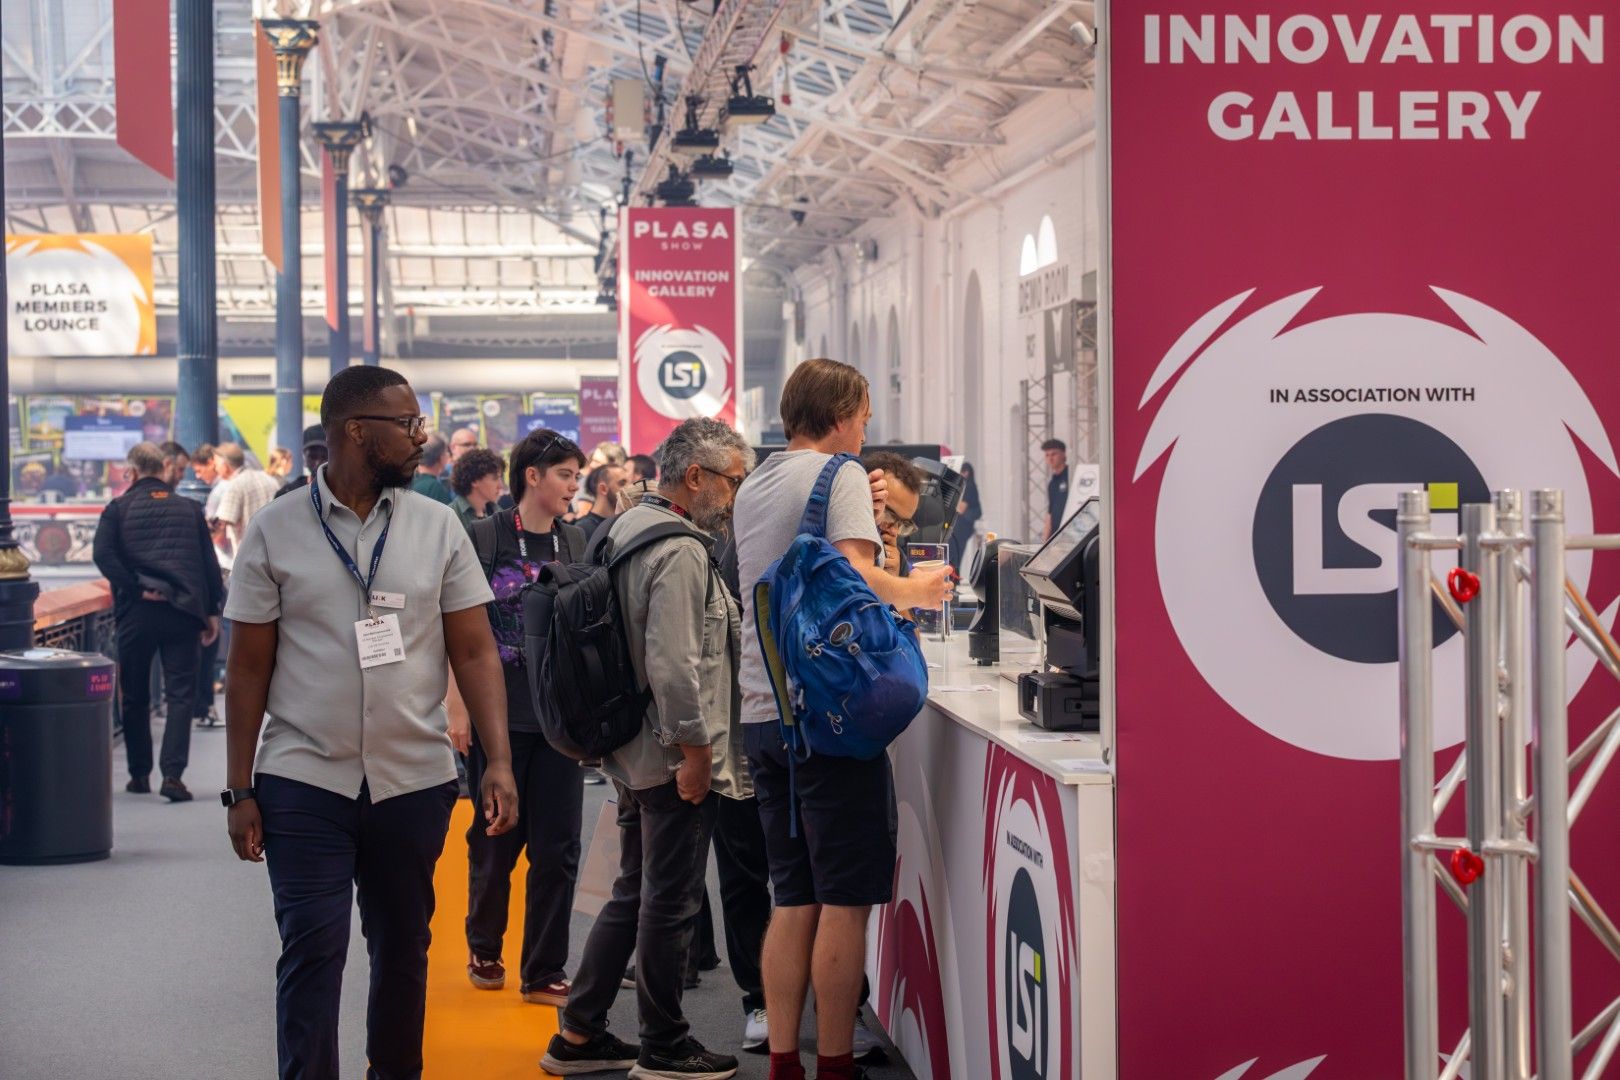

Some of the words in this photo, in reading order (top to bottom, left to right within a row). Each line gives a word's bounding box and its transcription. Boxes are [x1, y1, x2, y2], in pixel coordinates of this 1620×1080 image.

[1144, 14, 1604, 64] INNOVATION
[1207, 91, 1542, 141] GALLERY
[634, 221, 729, 239] PLASA
[661, 241, 703, 250] SHOW
[634, 270, 730, 282] INNOVATION
[31, 283, 91, 296] PLASA
[647, 285, 716, 298] GALLERY
[16, 301, 108, 314] MEMBERS
[24, 318, 100, 333] LOUNGE
[582, 389, 618, 400] PLA
[1270, 389, 1289, 403] IN
[1294, 388, 1421, 403] ASSOCIATION
[1426, 387, 1476, 402] WITH
